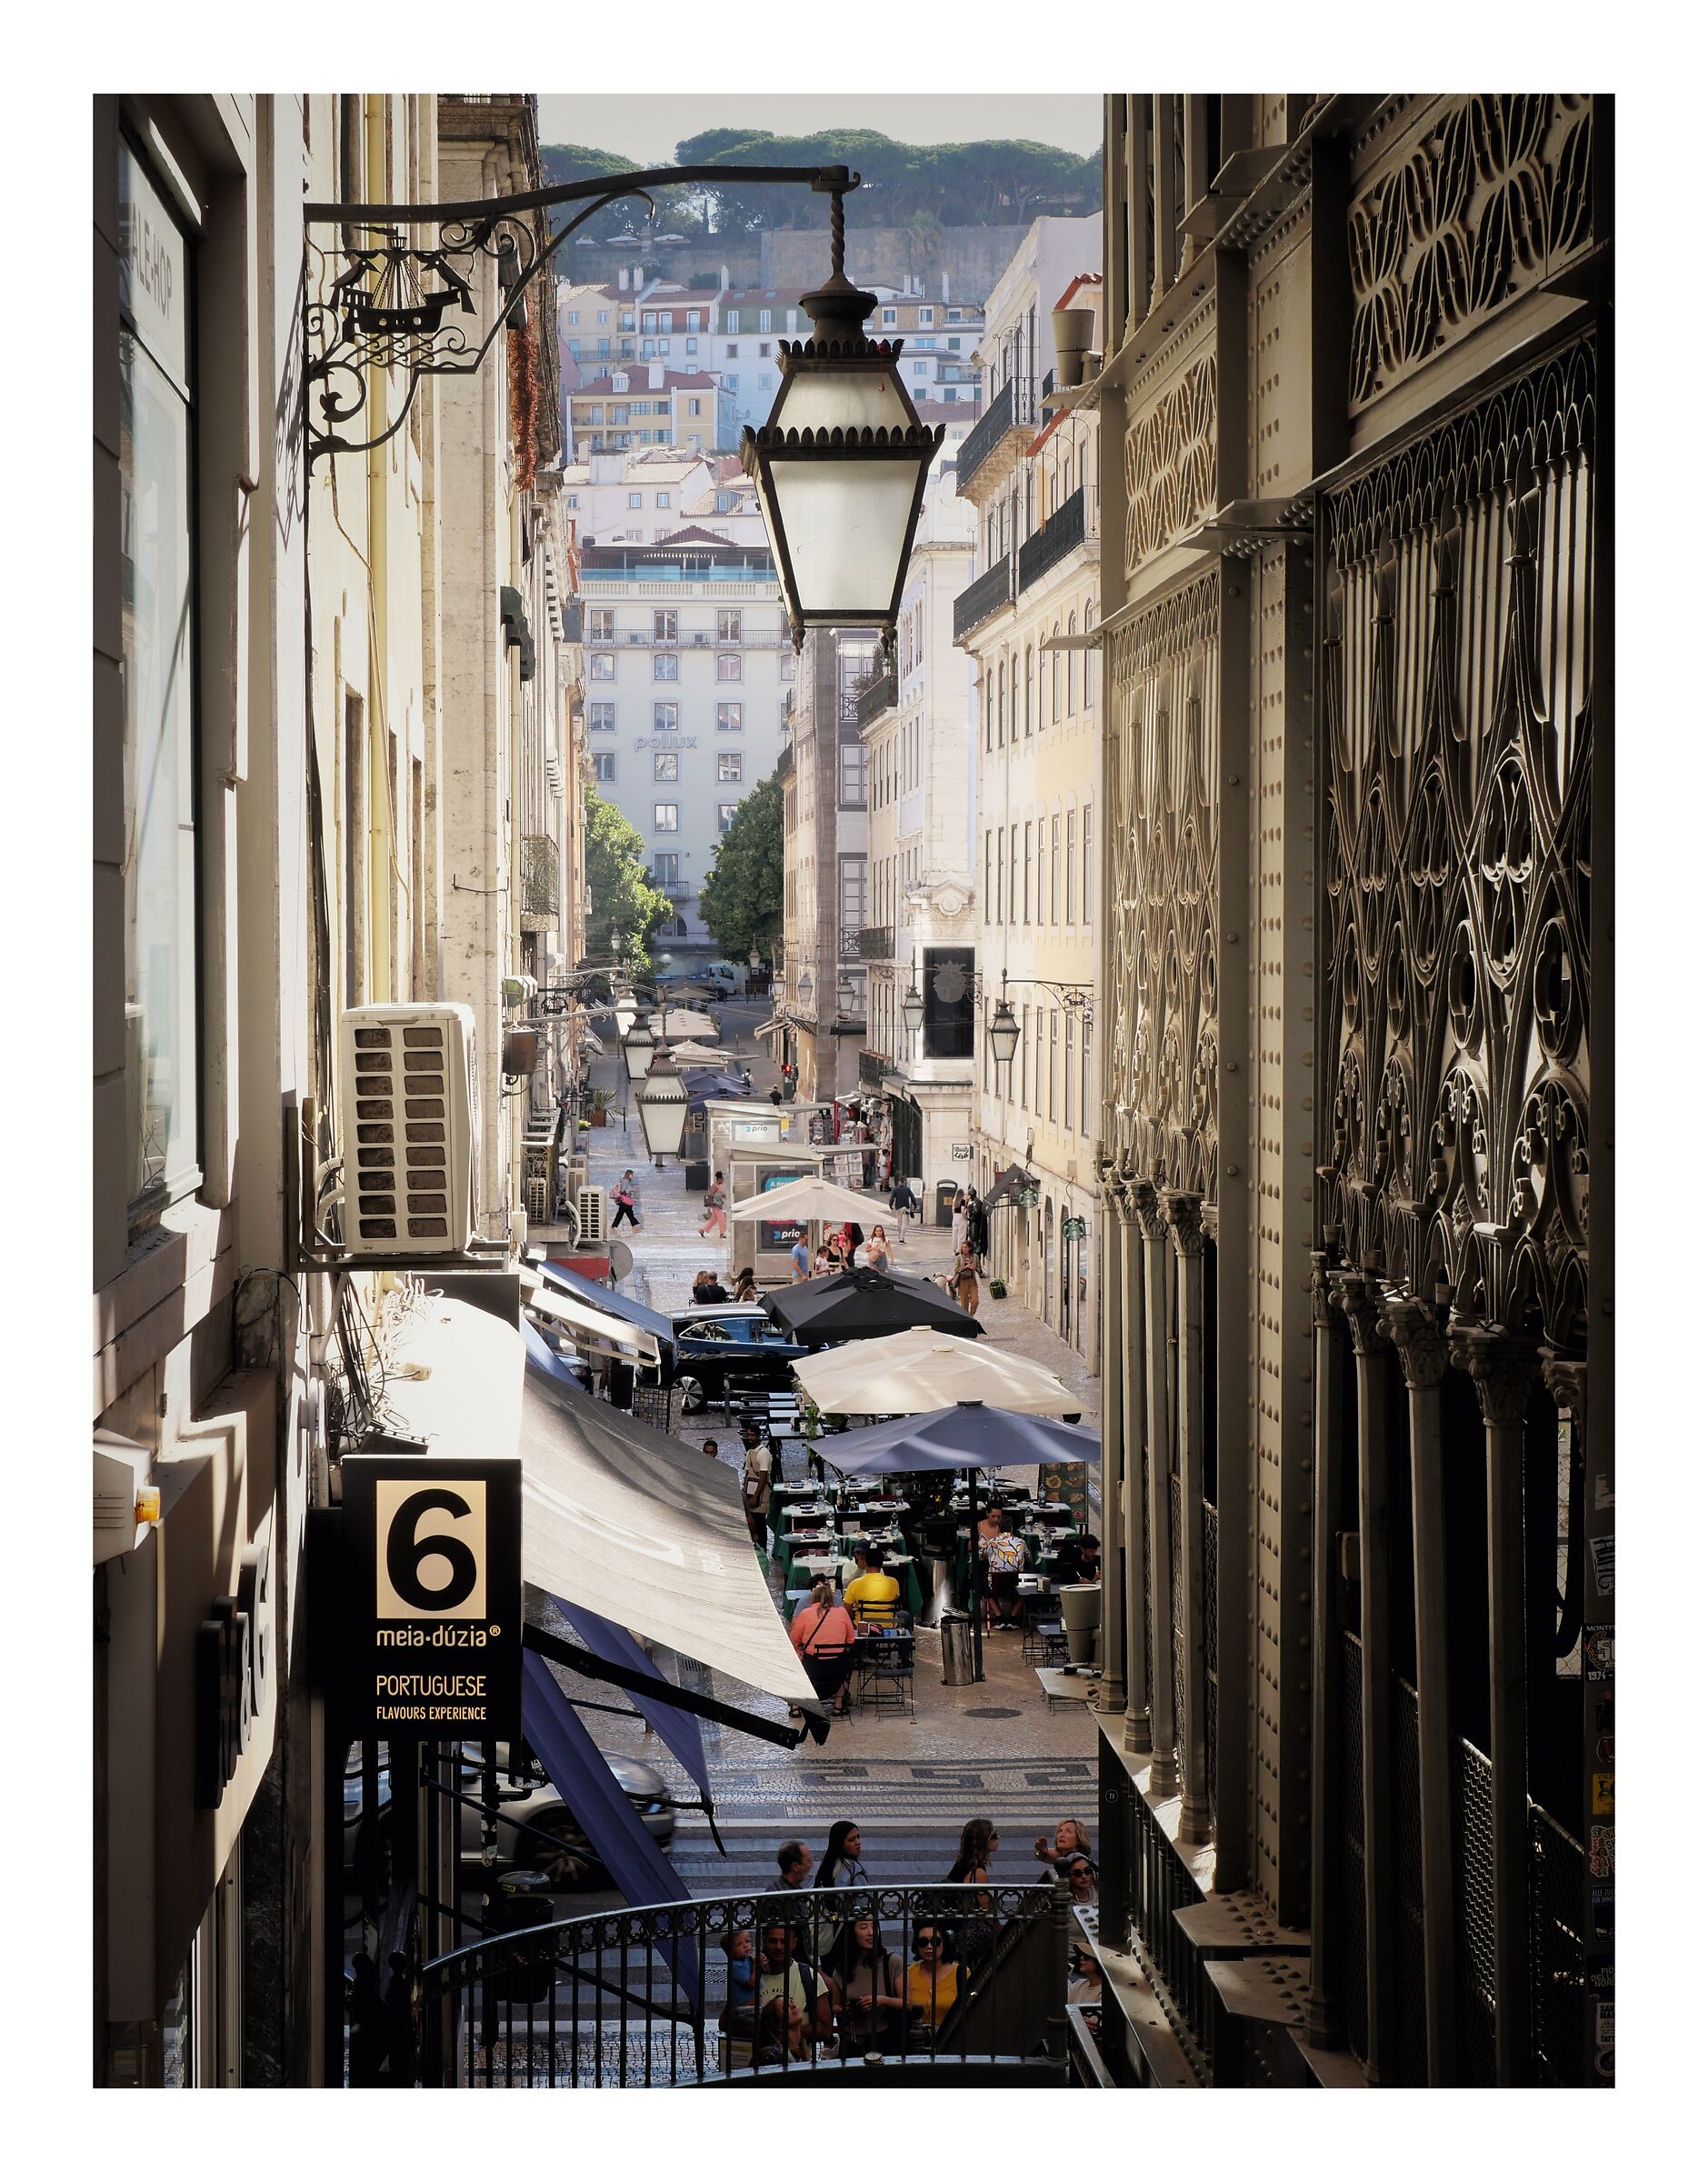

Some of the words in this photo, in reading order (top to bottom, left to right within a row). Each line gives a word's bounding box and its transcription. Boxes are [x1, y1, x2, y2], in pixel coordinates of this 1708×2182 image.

[634, 733, 697, 753] pollux
[752, 1125, 768, 1133] prio
[781, 1228, 801, 1240] prio
[387, 1489, 476, 1611] 6
[1587, 1671, 1606, 1681] 1974
[377, 1676, 486, 1696] PORTUGUESE
[377, 1707, 425, 1720] FLAVOURS
[429, 1707, 486, 1720] EXPERIENCE
